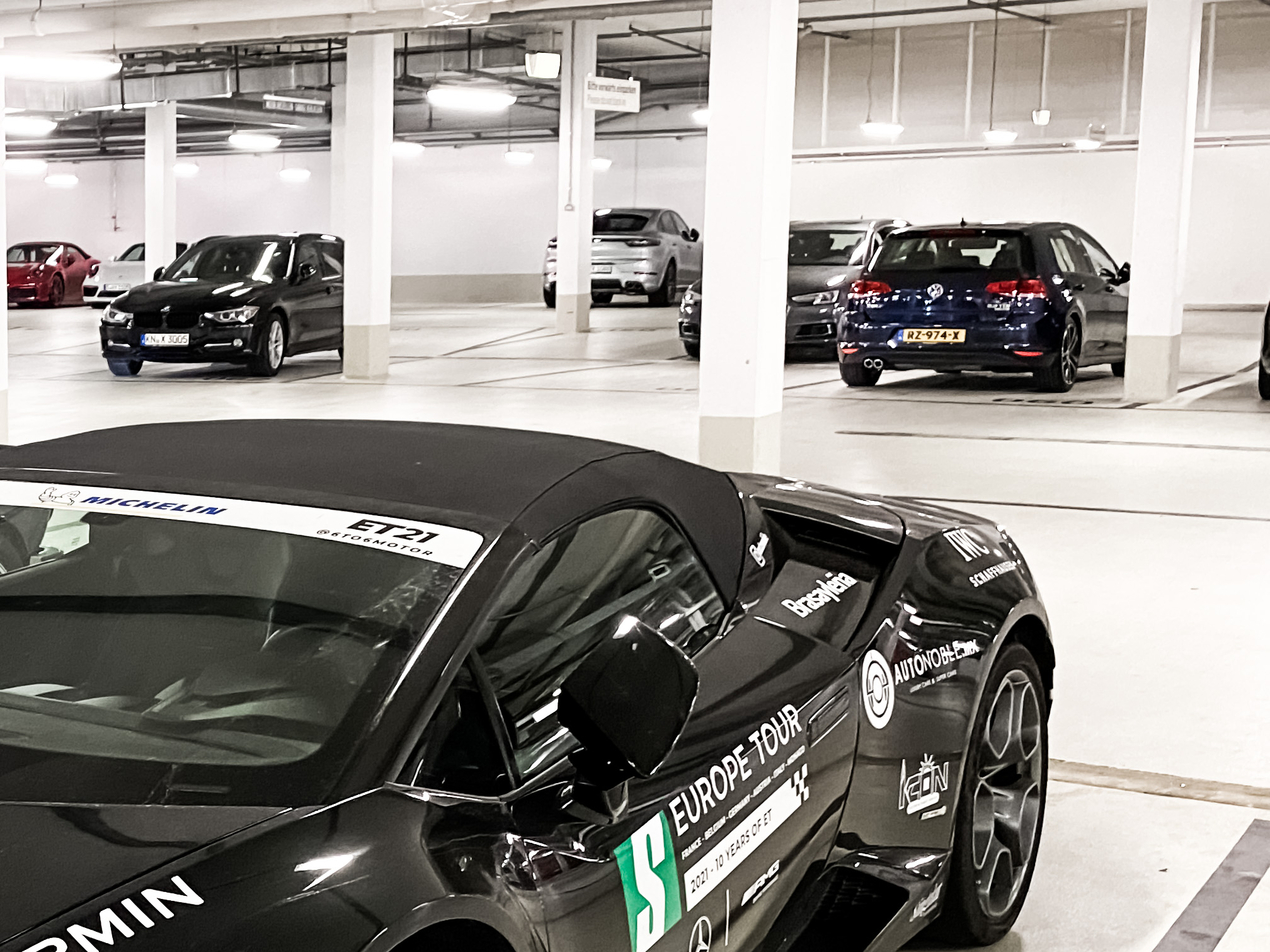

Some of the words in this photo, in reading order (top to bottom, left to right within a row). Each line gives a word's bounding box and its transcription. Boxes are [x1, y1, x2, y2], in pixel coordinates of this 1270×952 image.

[906, 330, 960, 341] RZ-974-X
[80, 495, 228, 517] MICHELIN
[316, 528, 434, 557] @6TO6MOTOR
[346, 518, 440, 544] ET21
[942, 528, 991, 562] IWC
[668, 744, 752, 836] EUROPE
[748, 703, 802, 764] TOUR
[690, 866, 710, 894] 2021
[714, 853, 726, 871] 10
[724, 828, 751, 862] YEARS
[751, 817, 762, 837] OF
[762, 807, 773, 827] ET
